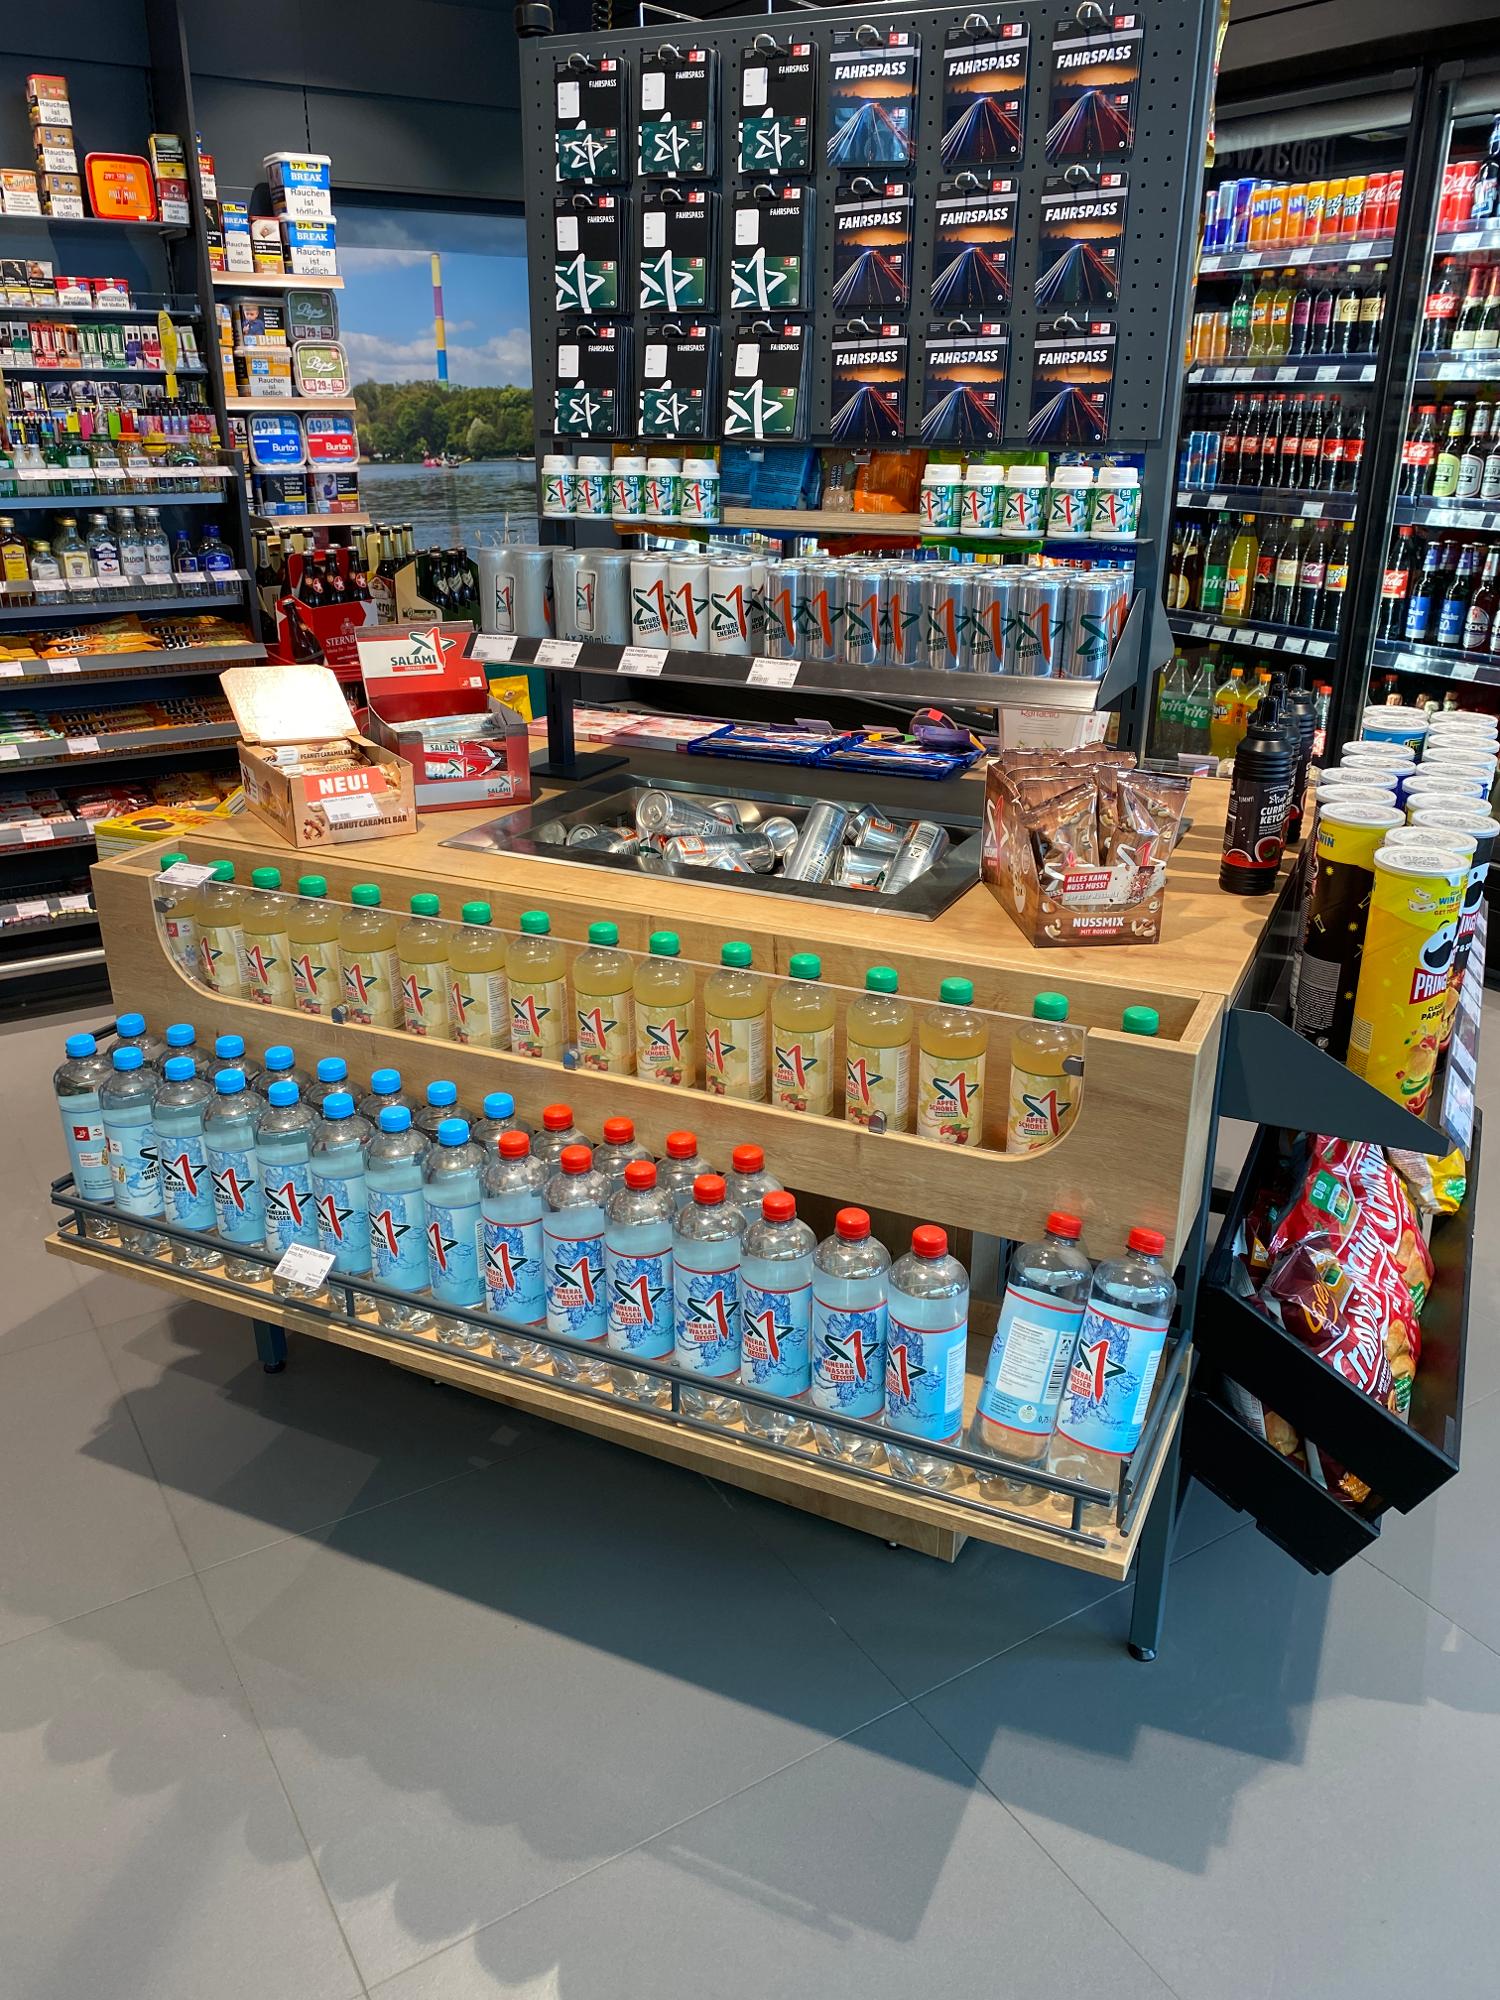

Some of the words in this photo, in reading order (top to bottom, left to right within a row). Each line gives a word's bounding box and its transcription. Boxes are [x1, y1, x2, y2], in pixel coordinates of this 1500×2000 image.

[1056, 45, 1132, 70] FAHRSPASS
[778, 64, 810, 74] FAHRSPASS
[949, 53, 1021, 76] FAHRSPASS
[835, 61, 907, 80] FAHRSPASS
[290, 174, 322, 182] BREAK
[290, 189, 326, 198] Rauchen
[675, 211, 704, 219] FAHRSPASS
[769, 207, 800, 216] FAHRSPASS
[1045, 202, 1118, 222] FAHRSPASS
[587, 215, 615, 223] FAHRSPASS
[838, 211, 902, 229] FAHRSPASS
[940, 207, 1008, 226] FAHRSPASS
[296, 232, 328, 241] BREAK
[296, 248, 331, 257] Rauchen
[302, 266, 329, 275] tödlich
[588, 344, 615, 352] FAHRSPASS
[677, 344, 705, 352] FAHRSPASS
[770, 343, 800, 351] FAHRSPASS
[836, 351, 899, 365] FAHRSPASS
[930, 350, 999, 365] FAHRSPASS
[1038, 350, 1108, 365] FAHRSPASS
[272, 443, 299, 452] Burton
[326, 442, 351, 452] Burton
[644, 616, 660, 624] PURE
[638, 622, 661, 632] ENERGY
[721, 622, 739, 631] PURE
[716, 628, 740, 638] ENERGY
[855, 632, 872, 640] PURE
[326, 635, 357, 648] STERNB
[850, 637, 873, 648] ENERGY
[976, 640, 993, 649] PURE
[1018, 649, 1042, 659] ENERGY
[391, 655, 436, 666] SALAMI
[1184, 706, 1209, 719] rite
[430, 744, 459, 752] SALAMI
[300, 752, 321, 760] PEANUT
[321, 750, 344, 758] CARAMEL
[318, 773, 369, 795] NEU!
[487, 787, 511, 795] SALAMI
[329, 821, 359, 831] PEANUT
[360, 816, 391, 827] CARAMEL
[393, 814, 408, 824] BAR
[1067, 875, 1088, 883] ALLES
[1067, 883, 1084, 891] NUSS
[1085, 882, 1107, 890] MUSS!
[1439, 896, 1455, 905] WIN
[1073, 917, 1125, 927] NUSSMIX
[777, 1068, 794, 1076] APFEL
[929, 1104, 958, 1112] SCHORLE
[1026, 1117, 1048, 1125] APFEL
[1018, 1122, 1048, 1130] SCHORLE
[614, 1304, 641, 1312] MINERAL
[615, 1310, 642, 1318] WASSER
[744, 1335, 766, 1346] MINERAL
[1333, 1283, 1385, 1394] Crunchi
[745, 1341, 768, 1353] WASSER
[823, 1359, 854, 1369] MINERAL
[824, 1366, 855, 1375] WASSER
[831, 1374, 856, 1382] CLASSIC
